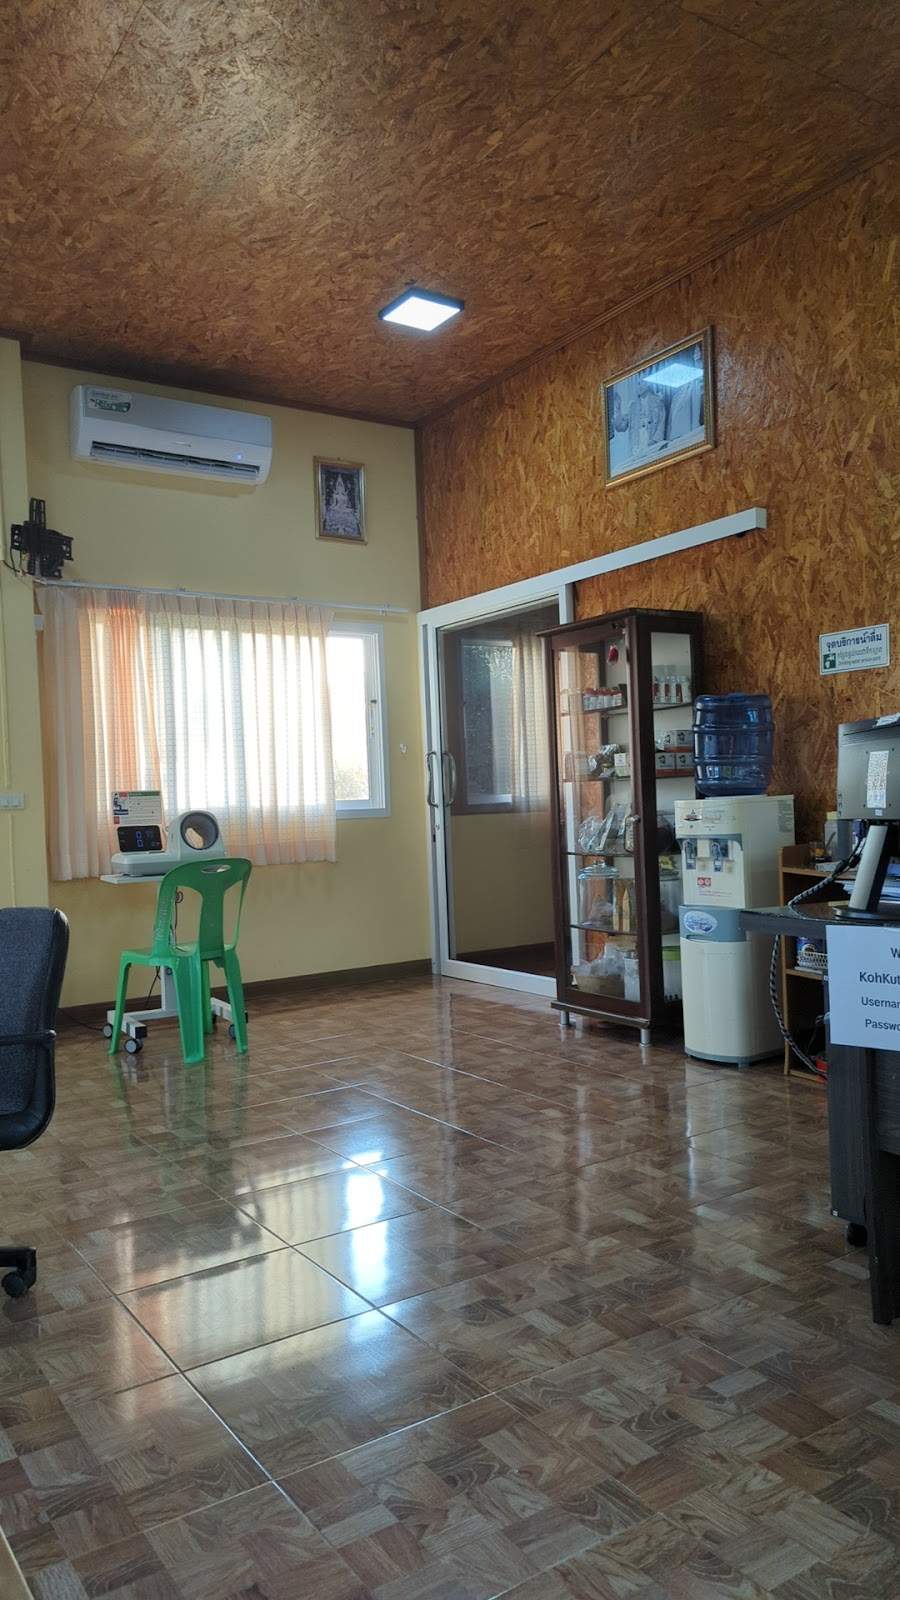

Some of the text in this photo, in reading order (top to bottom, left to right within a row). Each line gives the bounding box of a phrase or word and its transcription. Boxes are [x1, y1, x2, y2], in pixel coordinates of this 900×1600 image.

[827, 629, 882, 652] จุดบริการน้ำดื่ม
